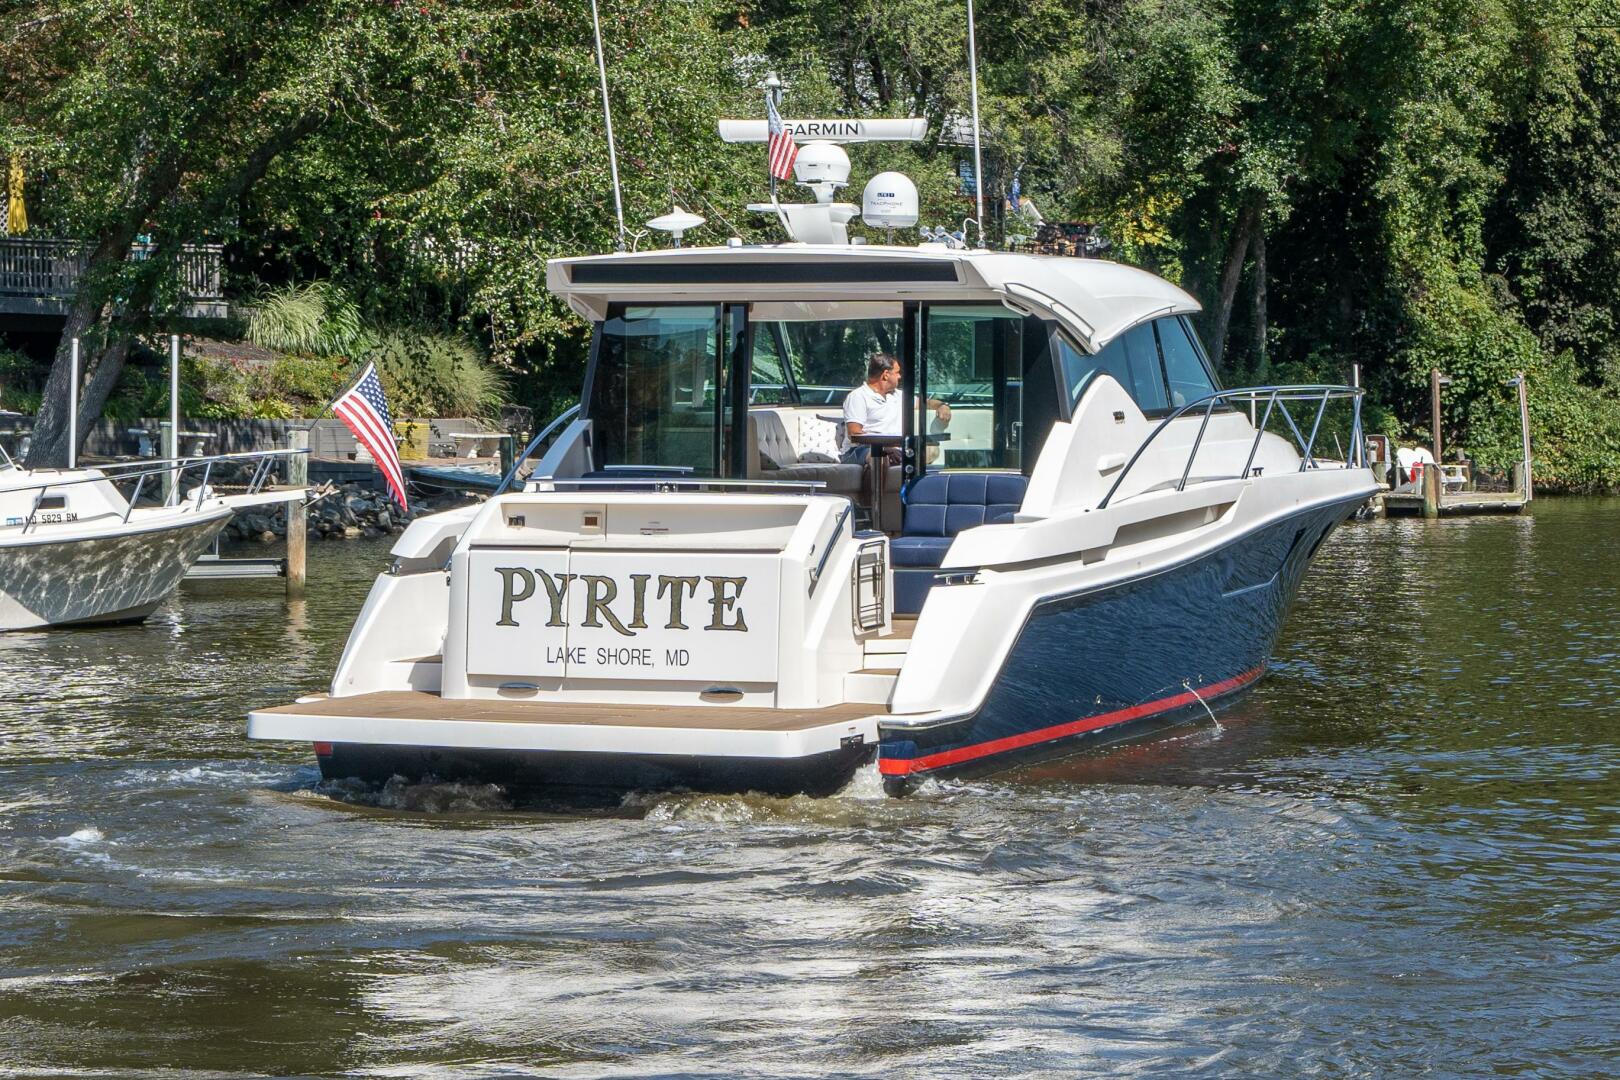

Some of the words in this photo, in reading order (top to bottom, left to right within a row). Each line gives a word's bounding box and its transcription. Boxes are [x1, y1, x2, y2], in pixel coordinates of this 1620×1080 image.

[41, 513, 62, 524] 5829
[66, 512, 79, 523] BM
[494, 567, 748, 637] PYRITE
[546, 647, 587, 665] LAKE
[596, 648, 655, 668] SHORE,
[665, 650, 690, 667] MD
